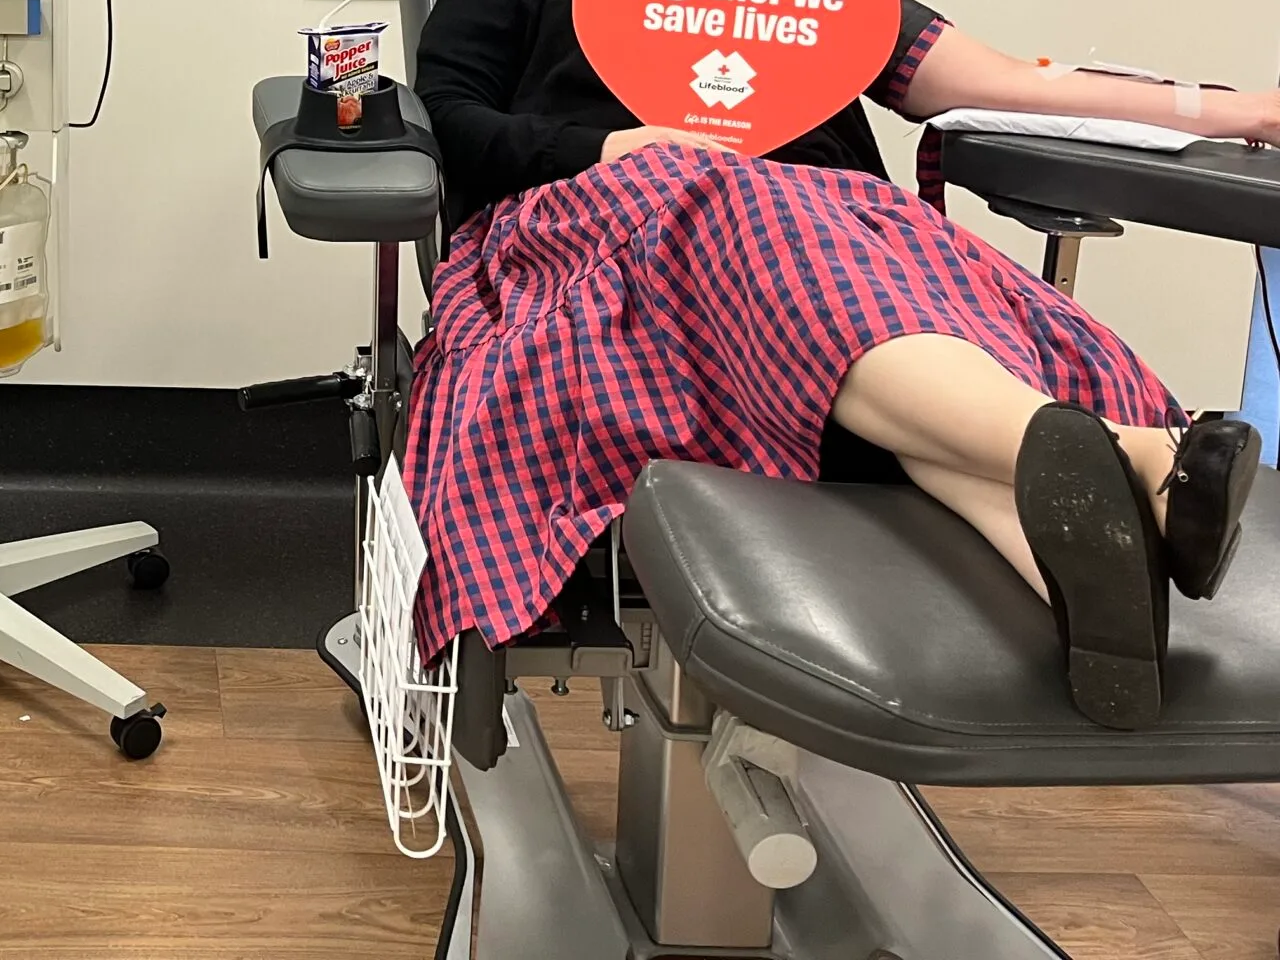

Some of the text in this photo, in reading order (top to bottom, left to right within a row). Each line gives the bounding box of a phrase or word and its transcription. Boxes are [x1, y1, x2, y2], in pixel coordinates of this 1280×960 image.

[643, 2, 819, 47] save lives
[325, 41, 372, 66] Popper
[335, 57, 366, 79] Juice
[347, 76, 367, 88] Apple
[699, 82, 745, 93] Lifeblood
[700, 116, 708, 125] IS
[708, 116, 722, 126] THE
[722, 118, 752, 130] REASON
